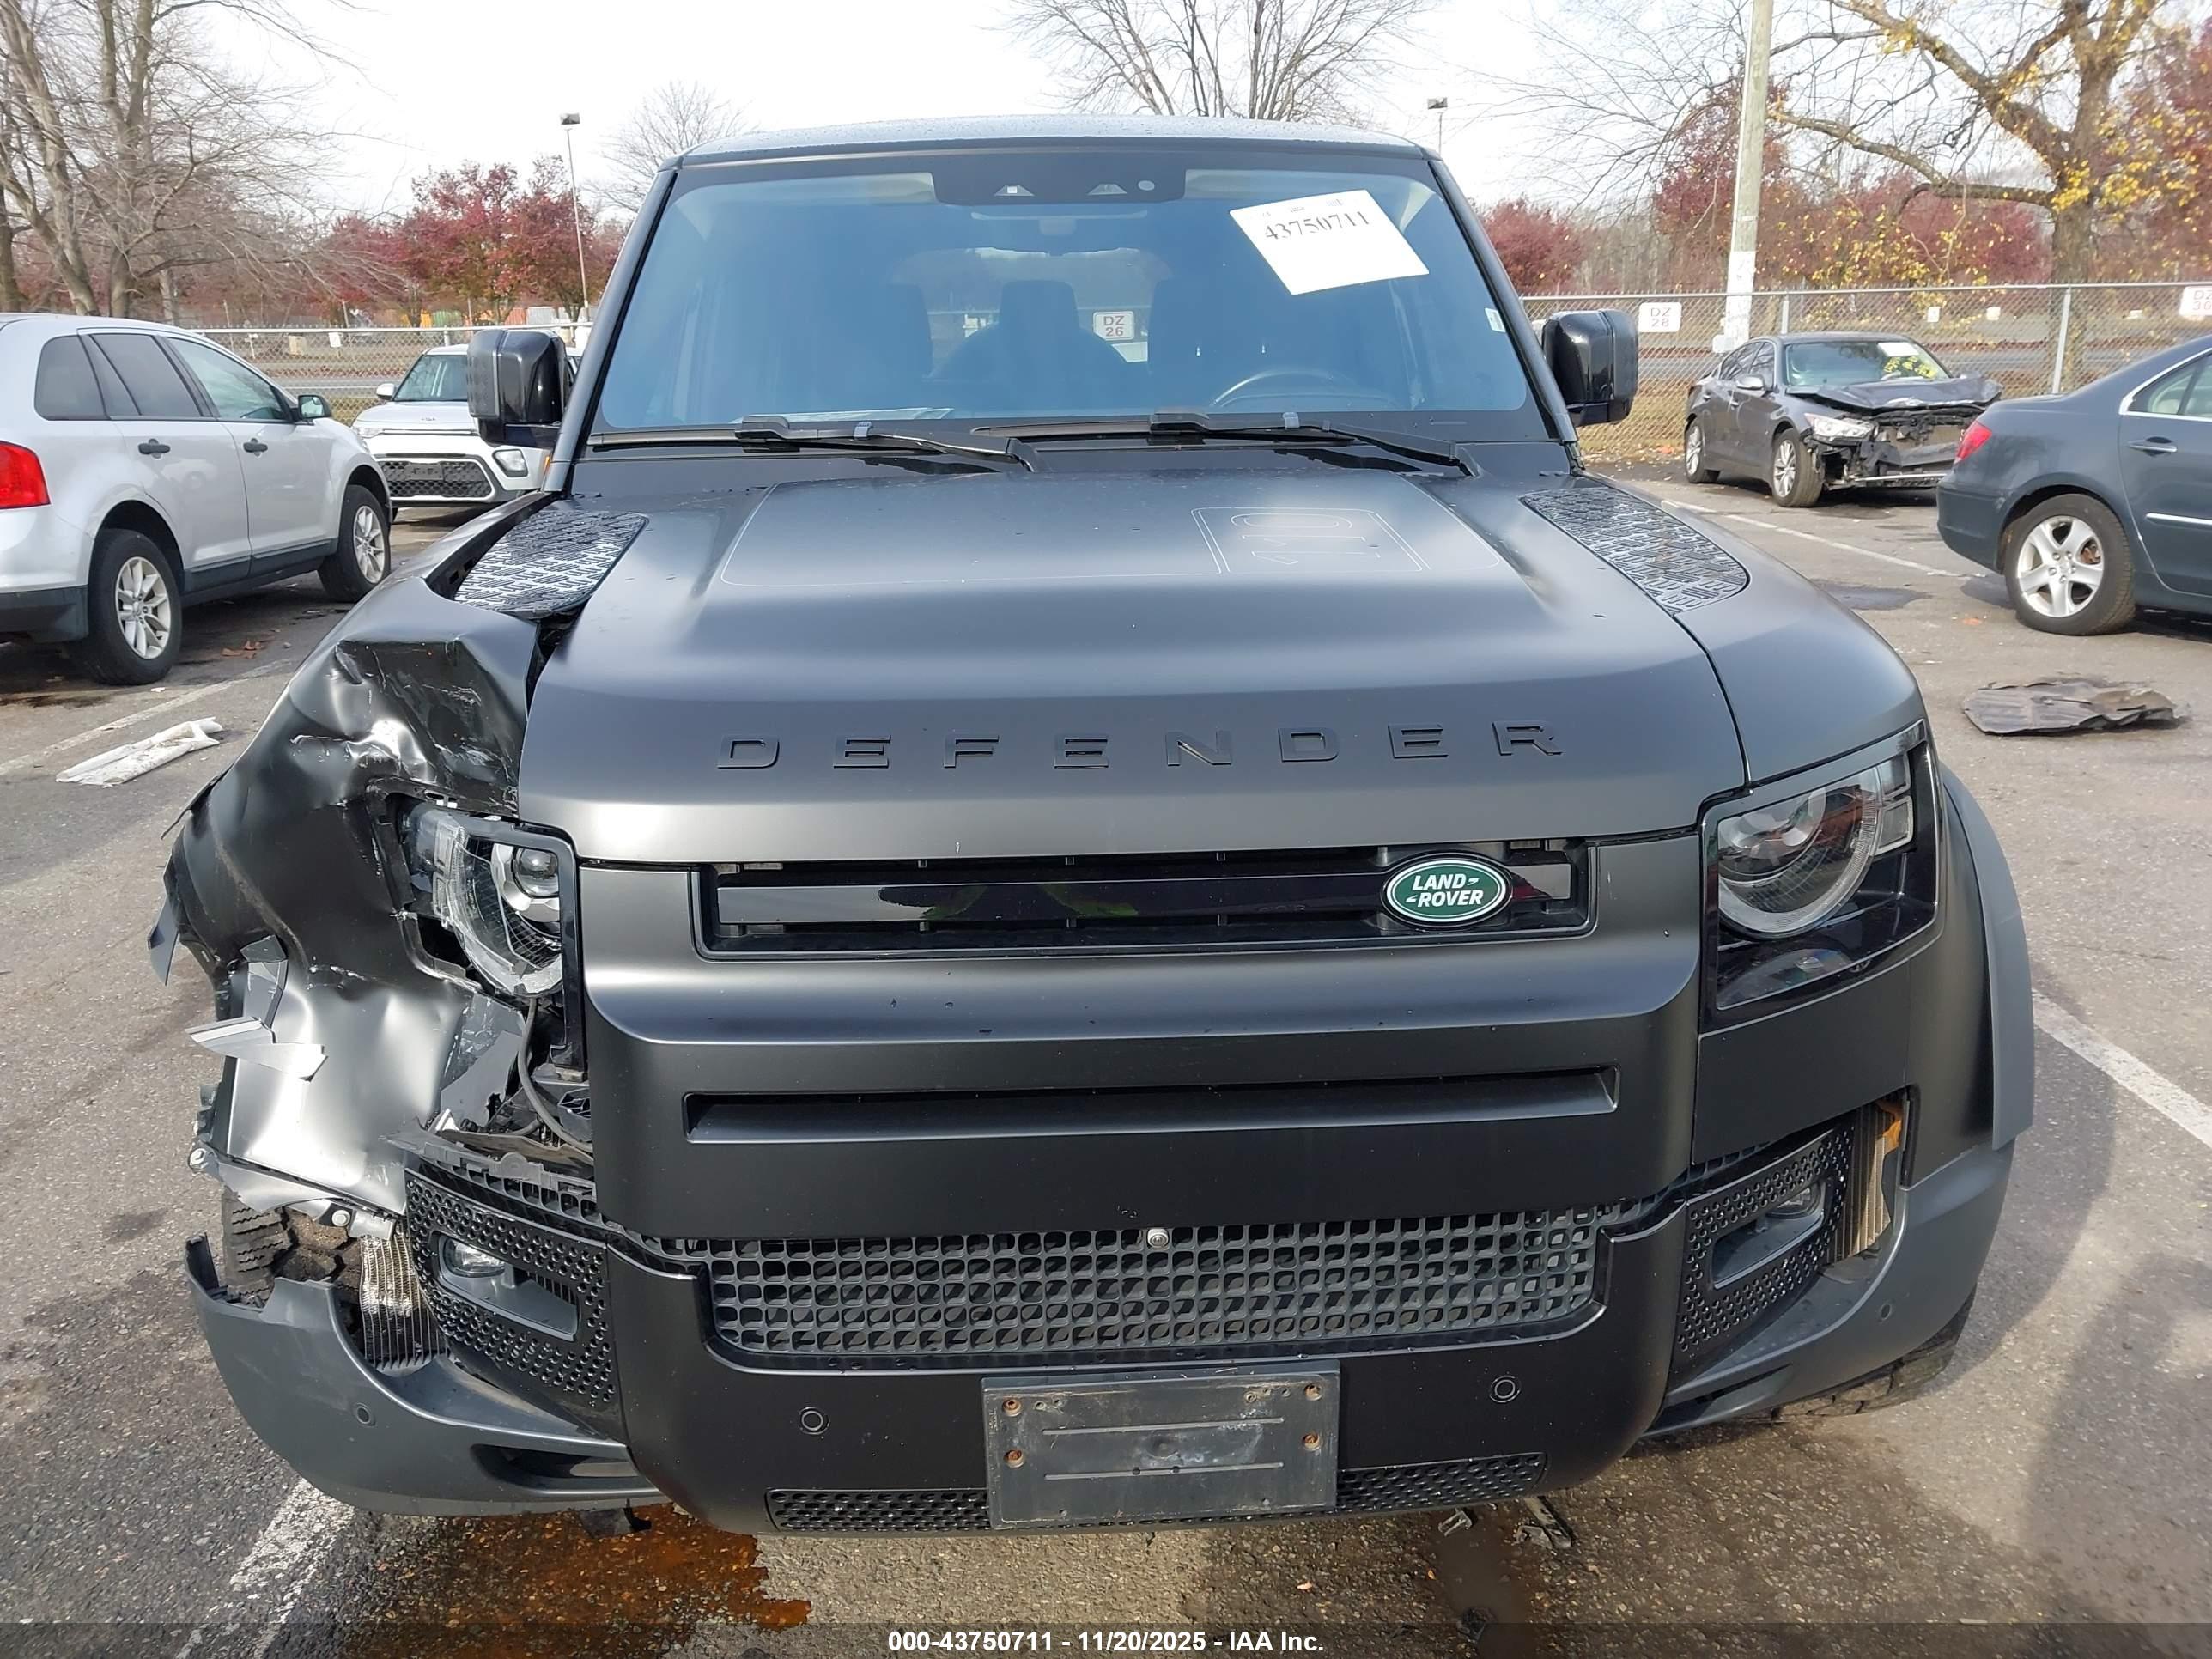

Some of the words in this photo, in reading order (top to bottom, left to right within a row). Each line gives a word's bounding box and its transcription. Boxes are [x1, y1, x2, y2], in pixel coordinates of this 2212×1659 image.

[1265, 211, 1369, 240] 43750711
[1650, 307, 1671, 317] DZ
[1103, 315, 1125, 325] DZ
[1651, 318, 1670, 328] 28
[1105, 326, 1124, 337] 26
[716, 720, 1562, 770] DEFENDER
[1412, 873, 1466, 891] LAND
[1417, 890, 1484, 908] ROVER
